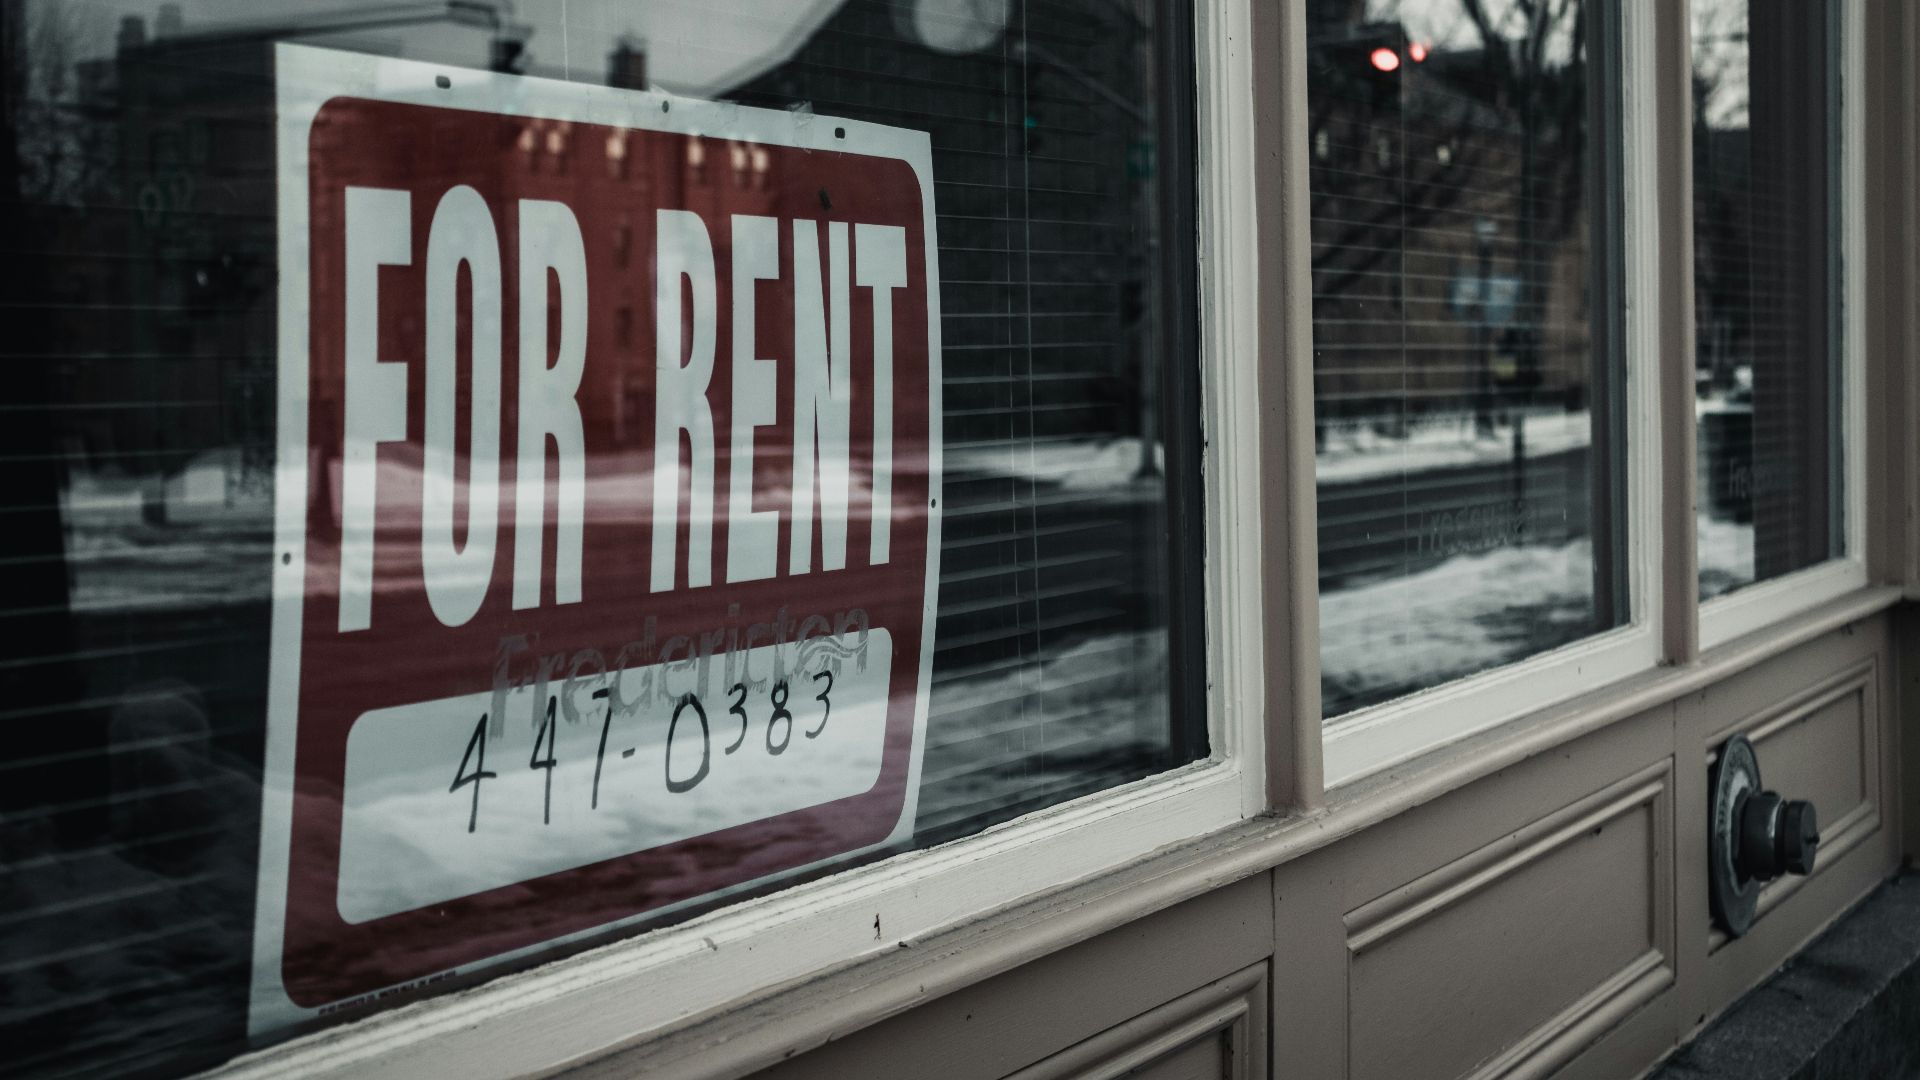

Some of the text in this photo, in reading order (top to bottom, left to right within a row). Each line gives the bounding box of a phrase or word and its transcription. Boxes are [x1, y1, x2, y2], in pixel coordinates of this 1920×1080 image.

[338, 185, 908, 632] FOR RENT
[489, 603, 869, 738] Fredericton
[450, 671, 833, 833] 447-0383
